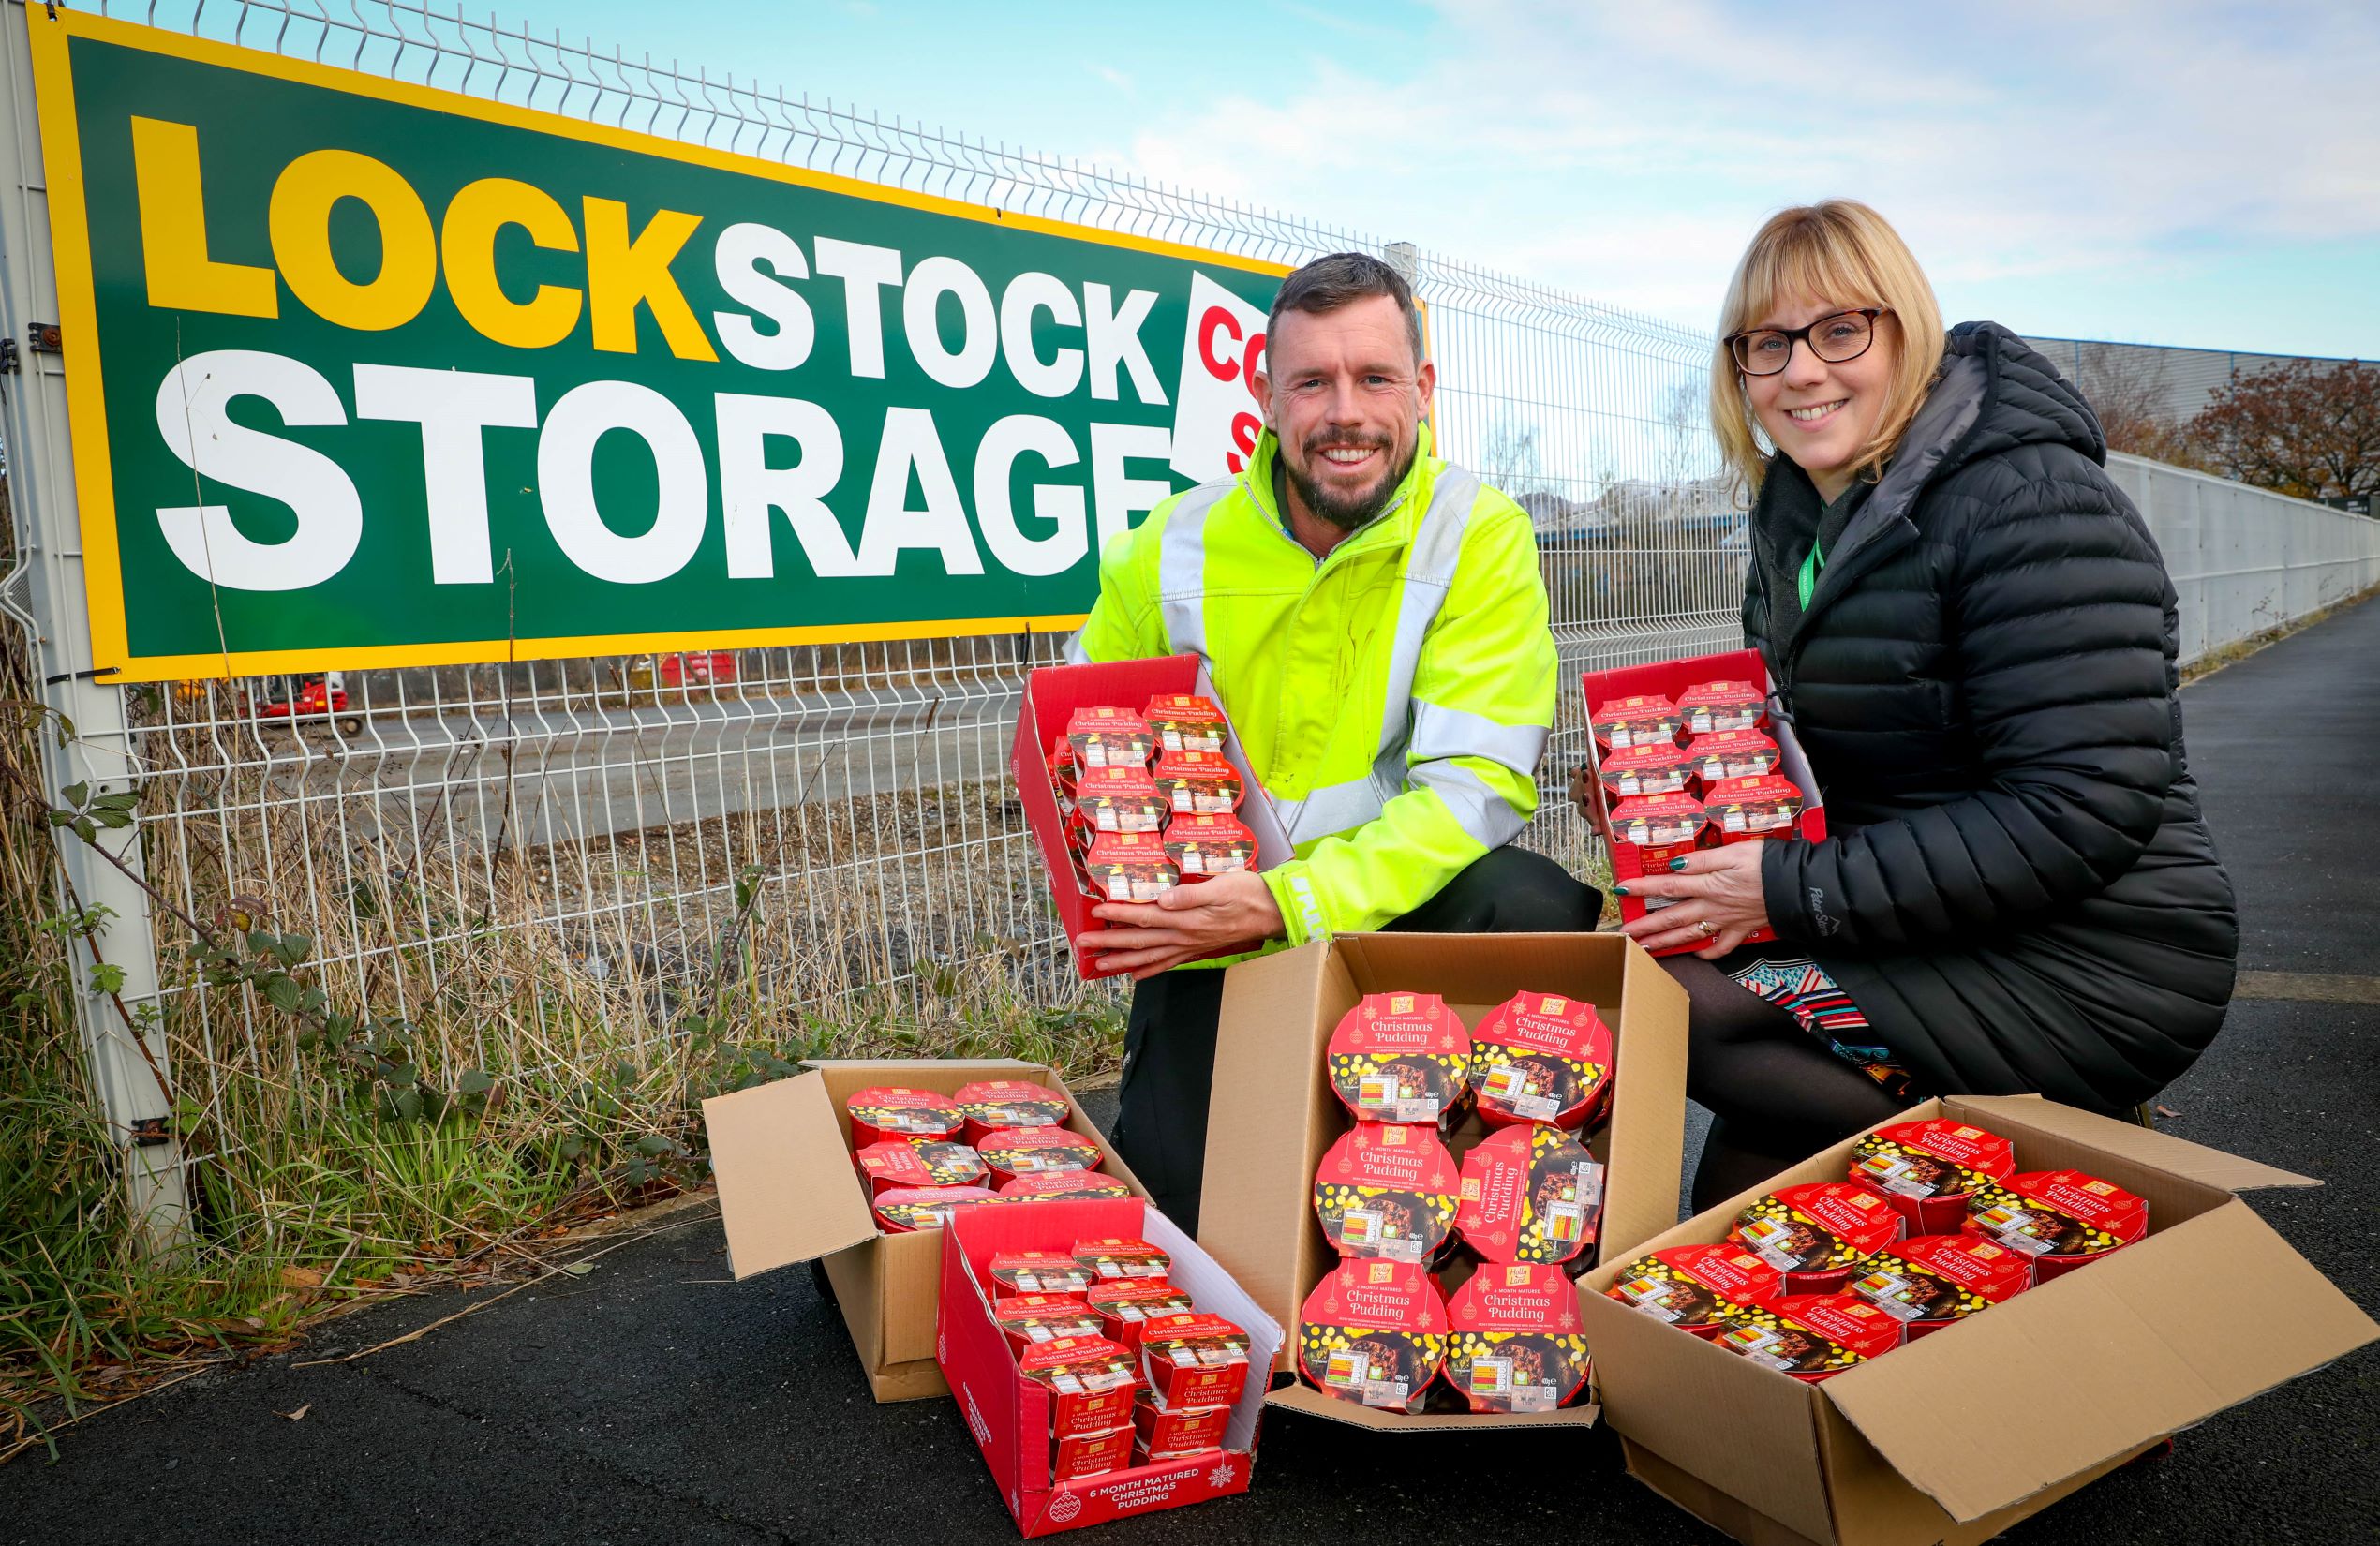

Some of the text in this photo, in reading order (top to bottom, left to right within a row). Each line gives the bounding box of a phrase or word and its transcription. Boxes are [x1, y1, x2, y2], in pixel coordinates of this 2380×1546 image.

[156, 349, 1171, 591] STORAGE
[1713, 786, 1792, 800] Christmas Pudding
[1619, 803, 1697, 814] Christmas Pudding
[1809, 886, 1824, 914] Peter
[1371, 1020, 1433, 1032] Christmas
[1515, 1017, 1576, 1037] Christmas
[1375, 1032, 1428, 1046] Pudding
[1517, 1027, 1569, 1048] Pudding
[1921, 1137, 1970, 1160] Pudding
[1923, 1131, 1982, 1156] Christmas
[1361, 1151, 1423, 1167] Christmas
[1363, 1164, 1418, 1182] Pudding
[1484, 1161, 1505, 1224] Christmas
[1496, 1167, 1518, 1221] Pudding
[2049, 1183, 2112, 1214] Christmas
[1818, 1196, 1867, 1228] Christmas
[2045, 1190, 2098, 1218] Pudding
[1812, 1201, 1853, 1231] Pudding
[1700, 1256, 1749, 1286] Christmas
[1929, 1254, 1978, 1281] Pudding
[1934, 1247, 1993, 1278] Christmas
[1693, 1262, 1733, 1290] Pudding
[1346, 1289, 1410, 1306] Christmas
[1484, 1294, 1551, 1307] Christmas
[1349, 1302, 1405, 1321] Pudding
[1488, 1307, 1545, 1323] Pudding
[1810, 1305, 1867, 1335] Christmas
[1148, 1328, 1193, 1336] Christmas
[1803, 1312, 1852, 1338] Pudding
[1029, 1344, 1115, 1363] Christmas Pudding
[1183, 1388, 1228, 1398] Christmas
[1185, 1395, 1225, 1404] Pudding
[1070, 1411, 1117, 1425] Christmas
[1073, 1420, 1112, 1431] Pudding
[1167, 1433, 1211, 1443] Christmas
[1168, 1439, 1206, 1449] Pudding
[1071, 1454, 1117, 1467] Christmas
[1073, 1461, 1112, 1473] Pudding
[1089, 1468, 1199, 1498] 6 MONTH MATURED
[1111, 1481, 1177, 1502] CHRISTMAS
[1117, 1492, 1169, 1509] PUDDING
